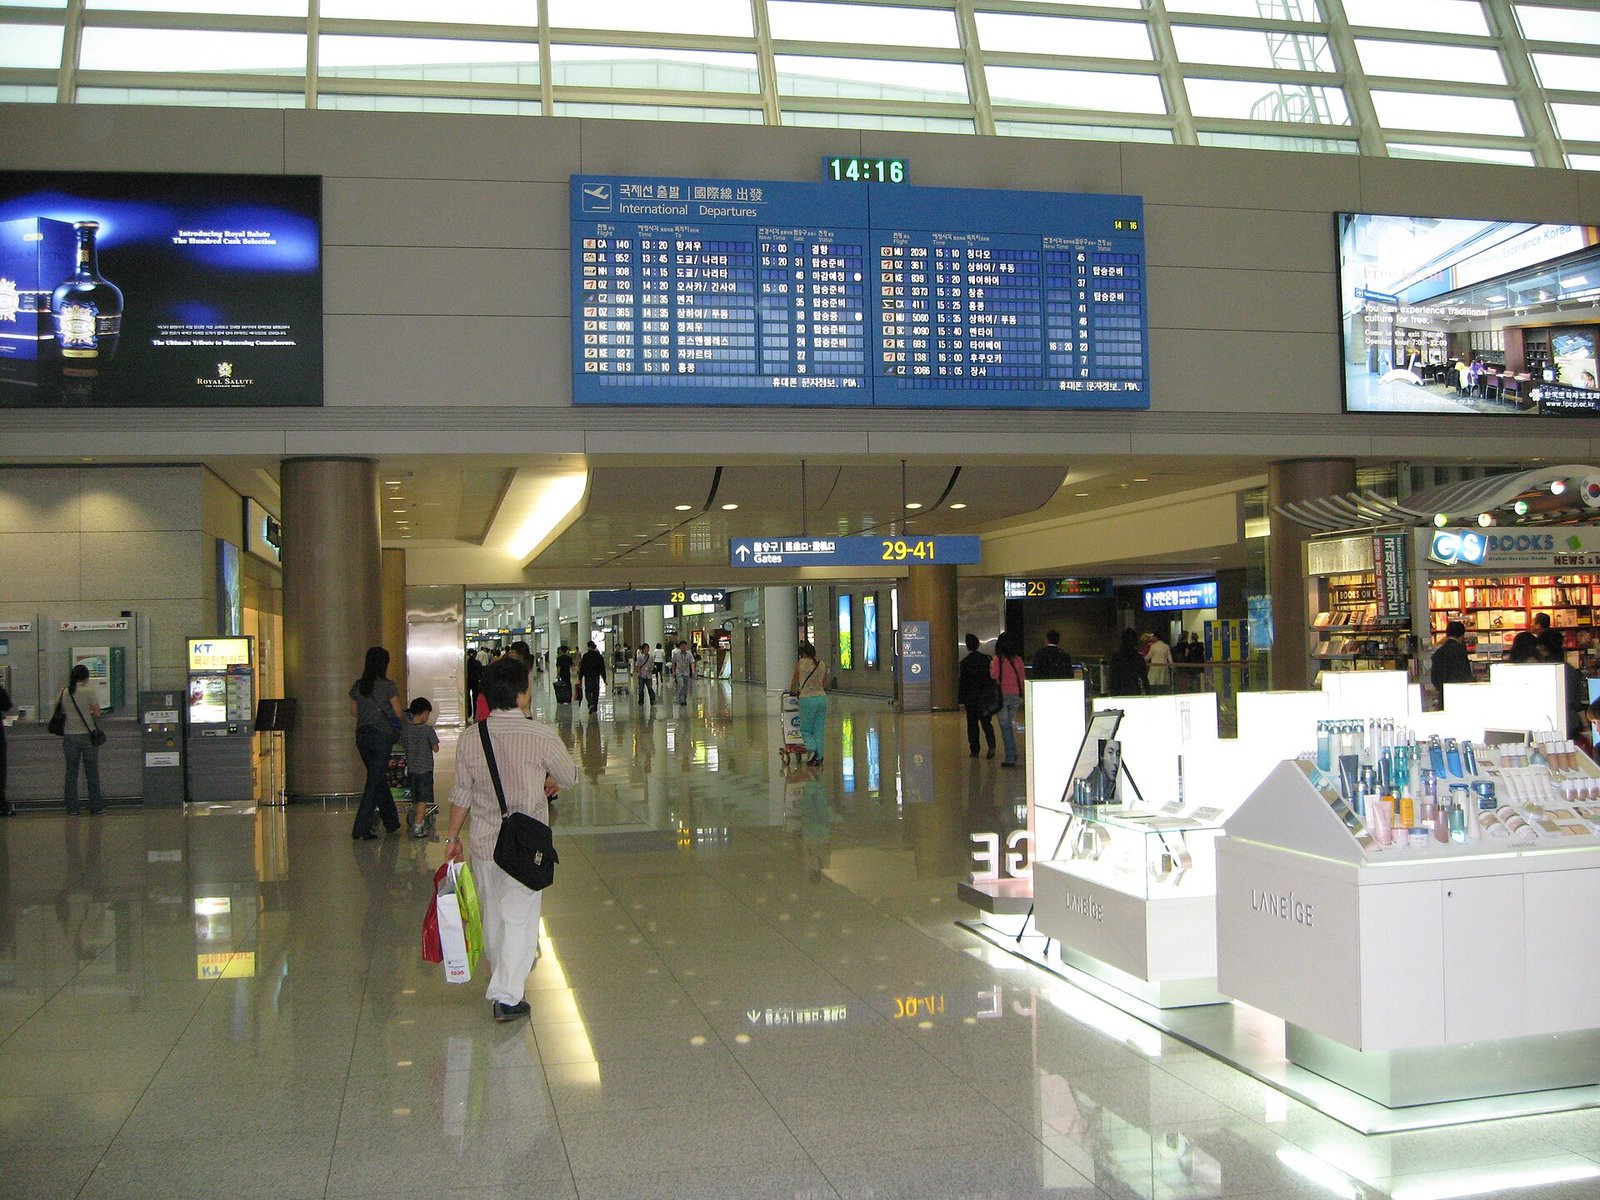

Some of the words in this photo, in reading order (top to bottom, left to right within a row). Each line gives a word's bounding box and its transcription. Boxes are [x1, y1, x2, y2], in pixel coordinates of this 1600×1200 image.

[831, 159, 904, 183] 14:16
[619, 184, 653, 198] 국제선
[657, 185, 679, 199] 출발
[694, 186, 732, 200] 國際線
[736, 187, 762, 201] 出發
[619, 203, 688, 215] International
[699, 205, 757, 218] Departures
[179, 230, 223, 239] Introducing
[224, 231, 246, 239] Royal
[1543, 225, 1572, 240] Korea
[1364, 304, 1379, 313] You
[1400, 306, 1445, 315] experience
[1448, 308, 1488, 316] traditional
[1411, 316, 1430, 325] free.
[1365, 338, 1392, 346] Opening
[1488, 534, 1554, 551] BOOKS
[882, 541, 935, 560] 29-41
[754, 554, 782, 564] Gates
[1553, 555, 1585, 565] NEWS
[1384, 537, 1399, 616] 국제전화카드
[1027, 581, 1046, 597] 29
[1340, 591, 1360, 600] BOOKS
[1361, 590, 1371, 599] ON
[670, 592, 686, 603] 29
[691, 593, 713, 602] Gate
[194, 643, 213, 653] KT
